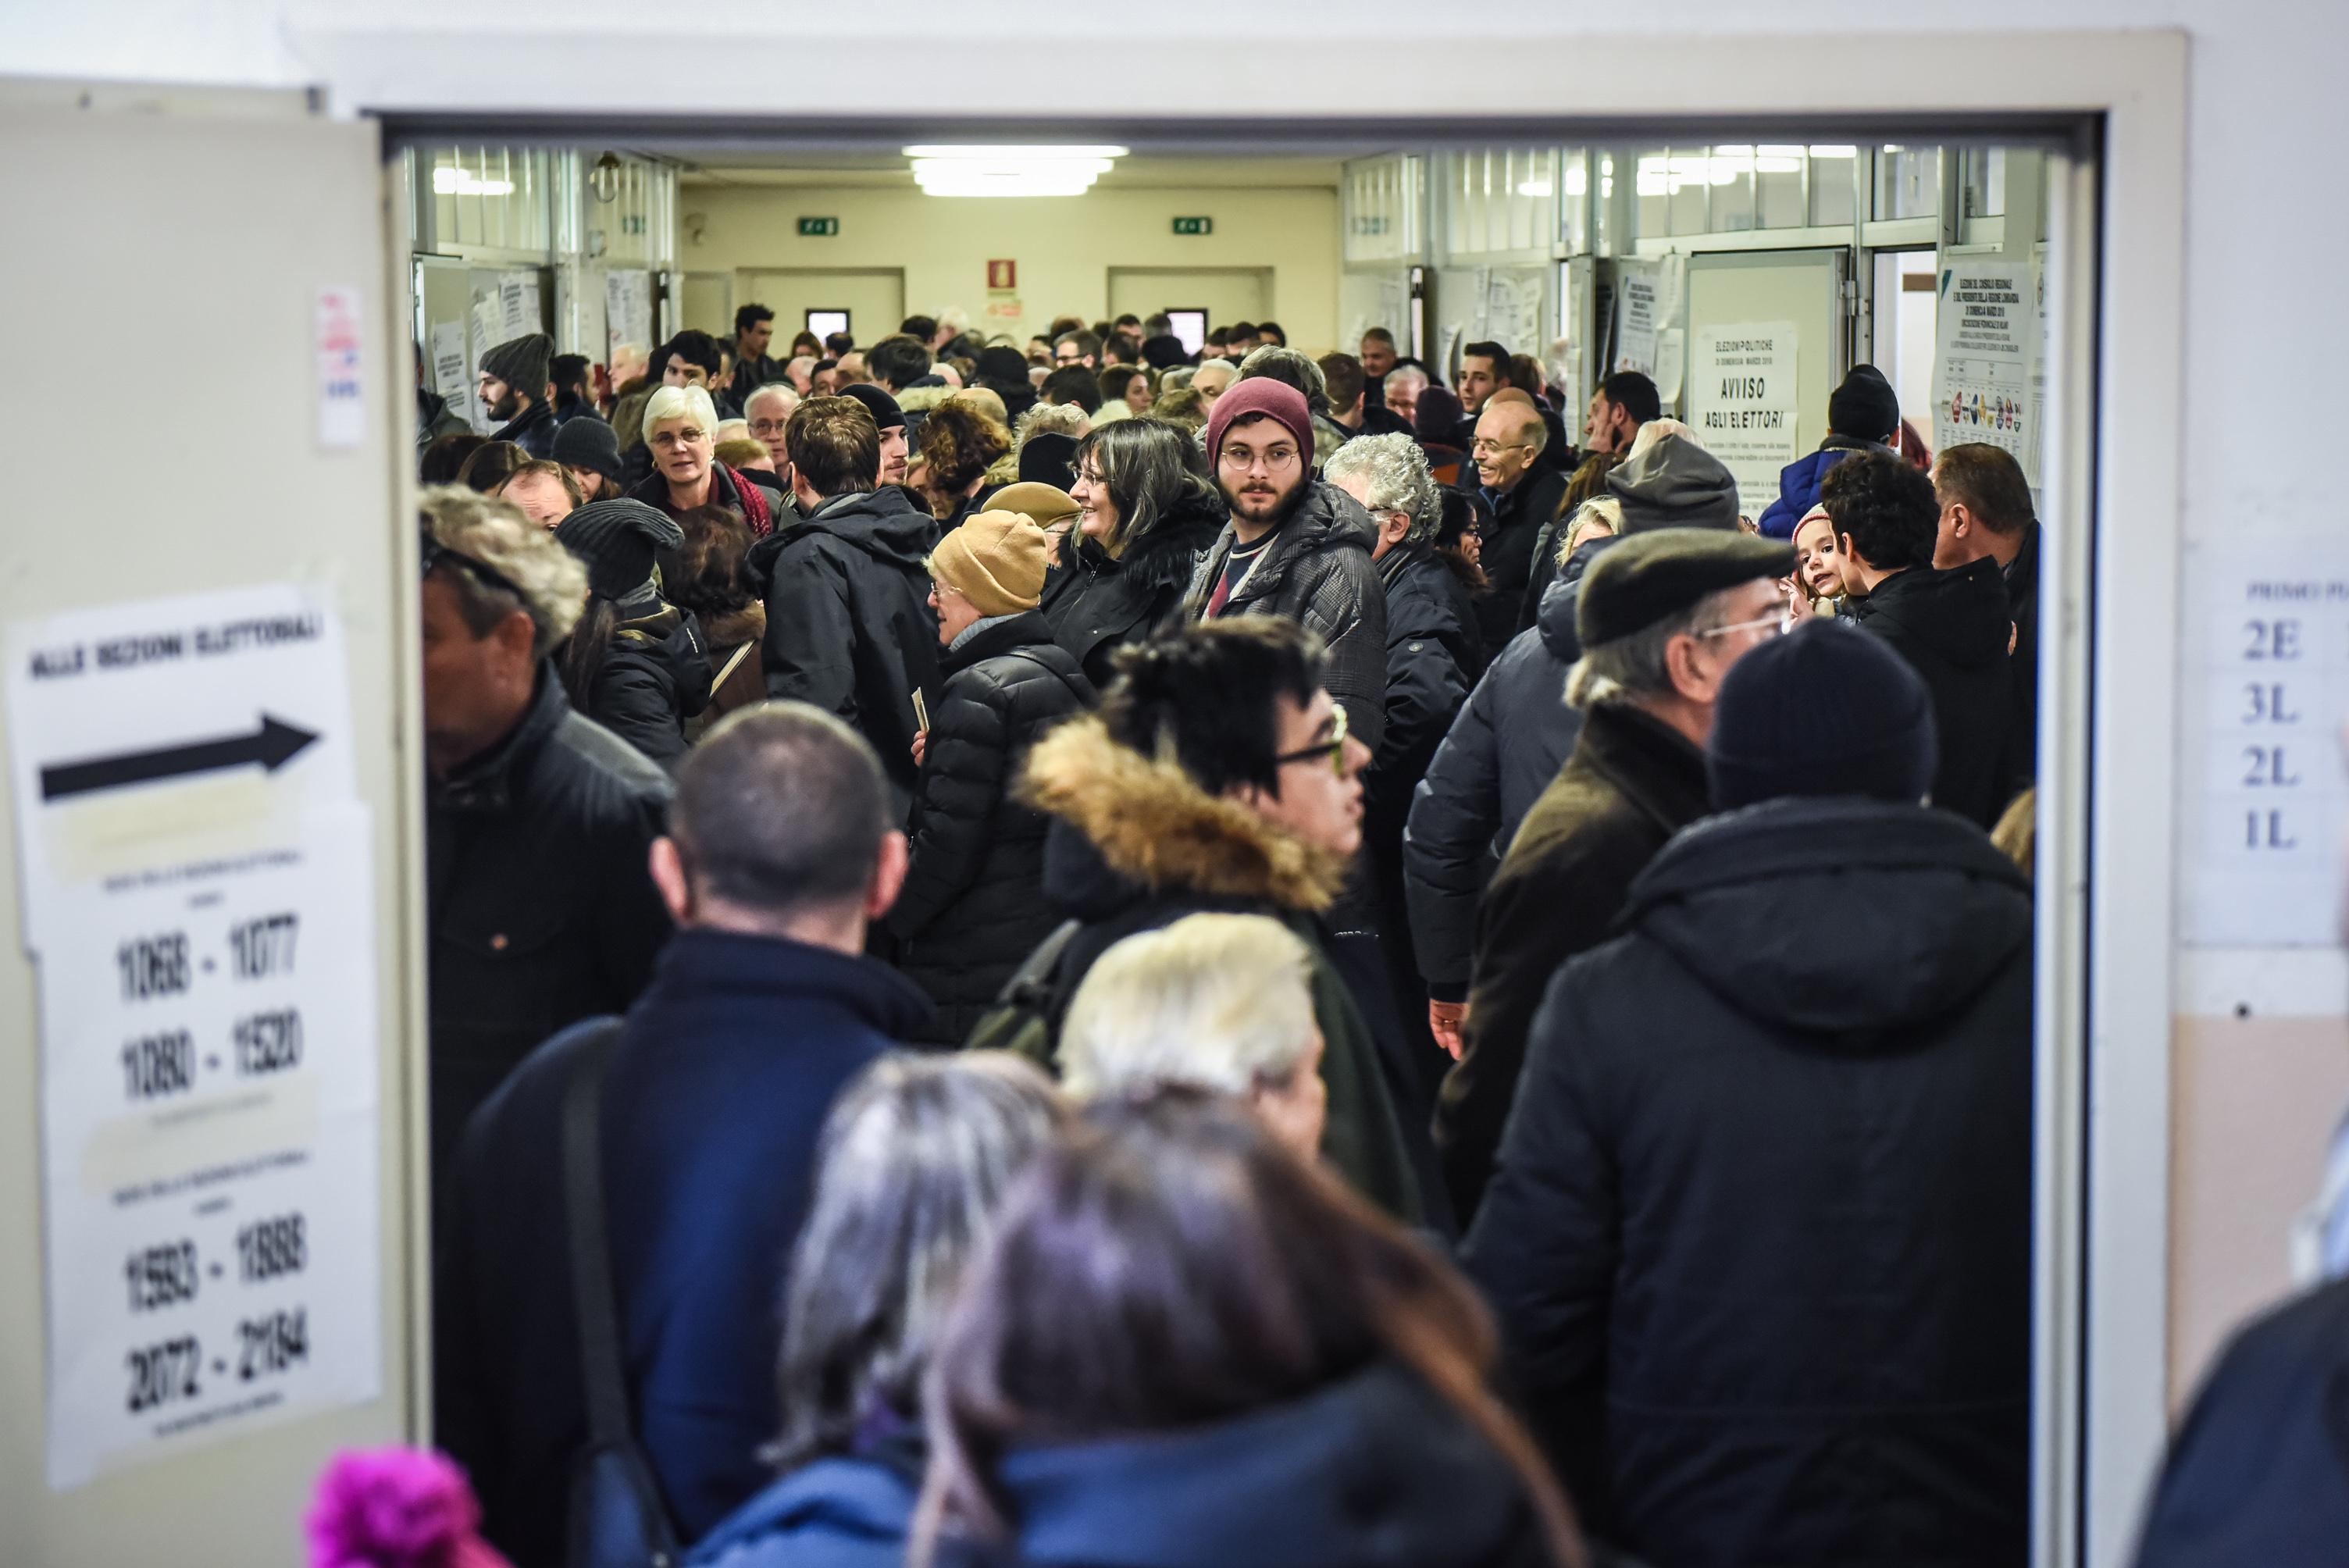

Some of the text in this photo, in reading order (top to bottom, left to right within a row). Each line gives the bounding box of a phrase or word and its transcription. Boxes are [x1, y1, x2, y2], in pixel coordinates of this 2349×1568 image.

[1720, 376, 1765, 399] AVVISO
[1705, 411, 1784, 429] AGLI ELETTORI
[2247, 582, 2319, 601] PRIMO
[2243, 619, 2302, 661] 2E
[2240, 682, 2301, 724] 3L
[2242, 745, 2301, 787] 2L
[2245, 808, 2299, 850] 1L
